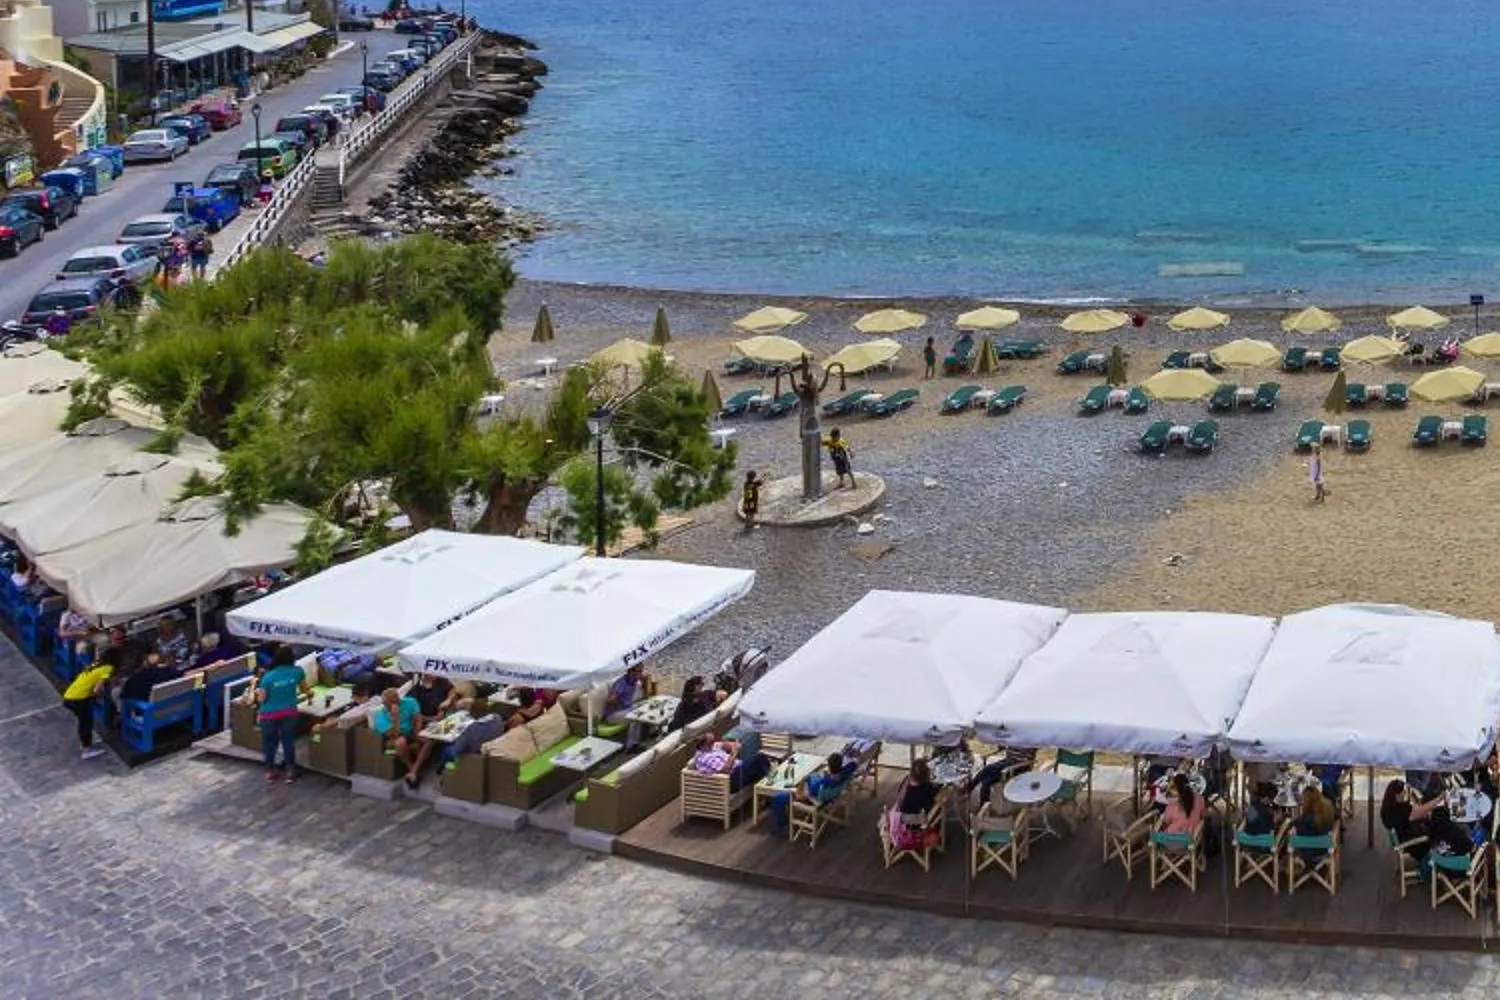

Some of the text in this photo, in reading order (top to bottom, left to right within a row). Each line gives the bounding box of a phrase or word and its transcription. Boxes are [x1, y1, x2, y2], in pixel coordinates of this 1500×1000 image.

[250, 621, 274, 634] FIX
[622, 644, 649, 666] FIX
[425, 659, 450, 671] FIX
